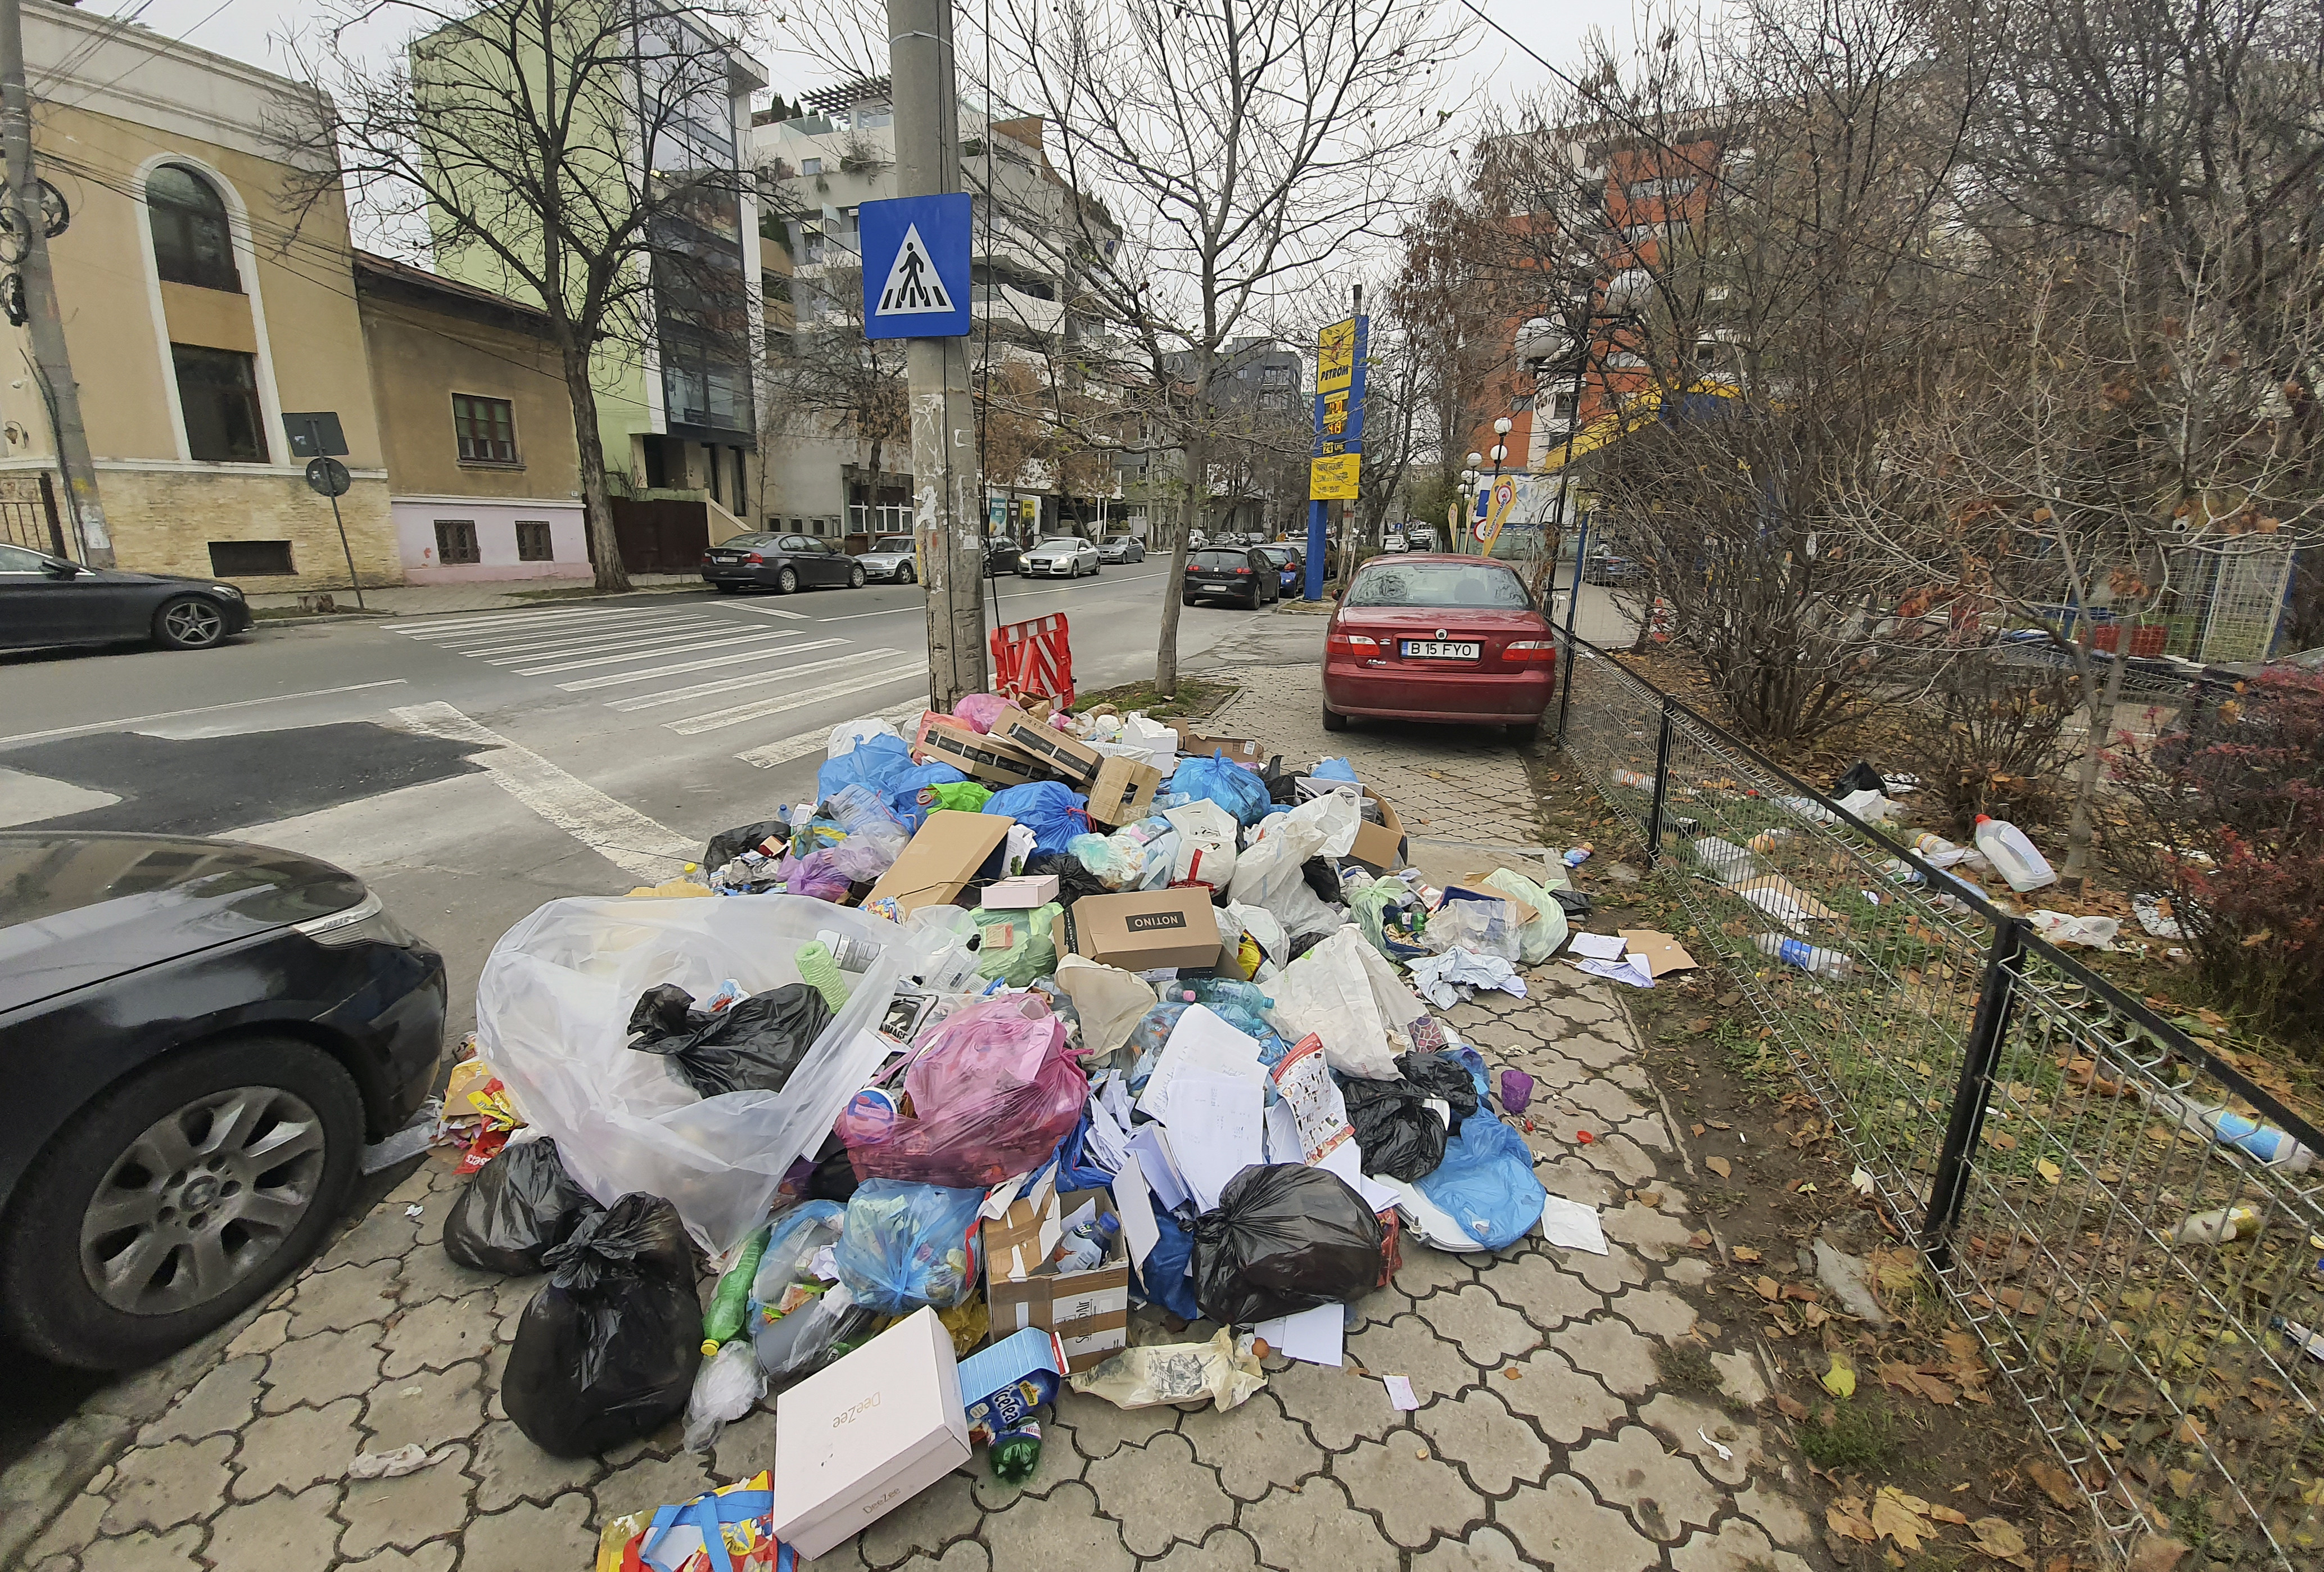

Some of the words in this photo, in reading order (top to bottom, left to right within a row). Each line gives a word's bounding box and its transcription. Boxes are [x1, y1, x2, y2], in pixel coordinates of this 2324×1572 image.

[1321, 365, 1348, 381] PETROM
[1495, 499, 1507, 518] HOURS
[1412, 643, 1420, 654] B
[1425, 643, 1437, 655] 15
[1443, 644, 1471, 656] FYO
[1134, 915, 1178, 927] NOTINO
[465, 1154, 491, 1166] sers
[833, 1392, 881, 1428] DeeZee
[862, 1488, 901, 1514] DeeZee
